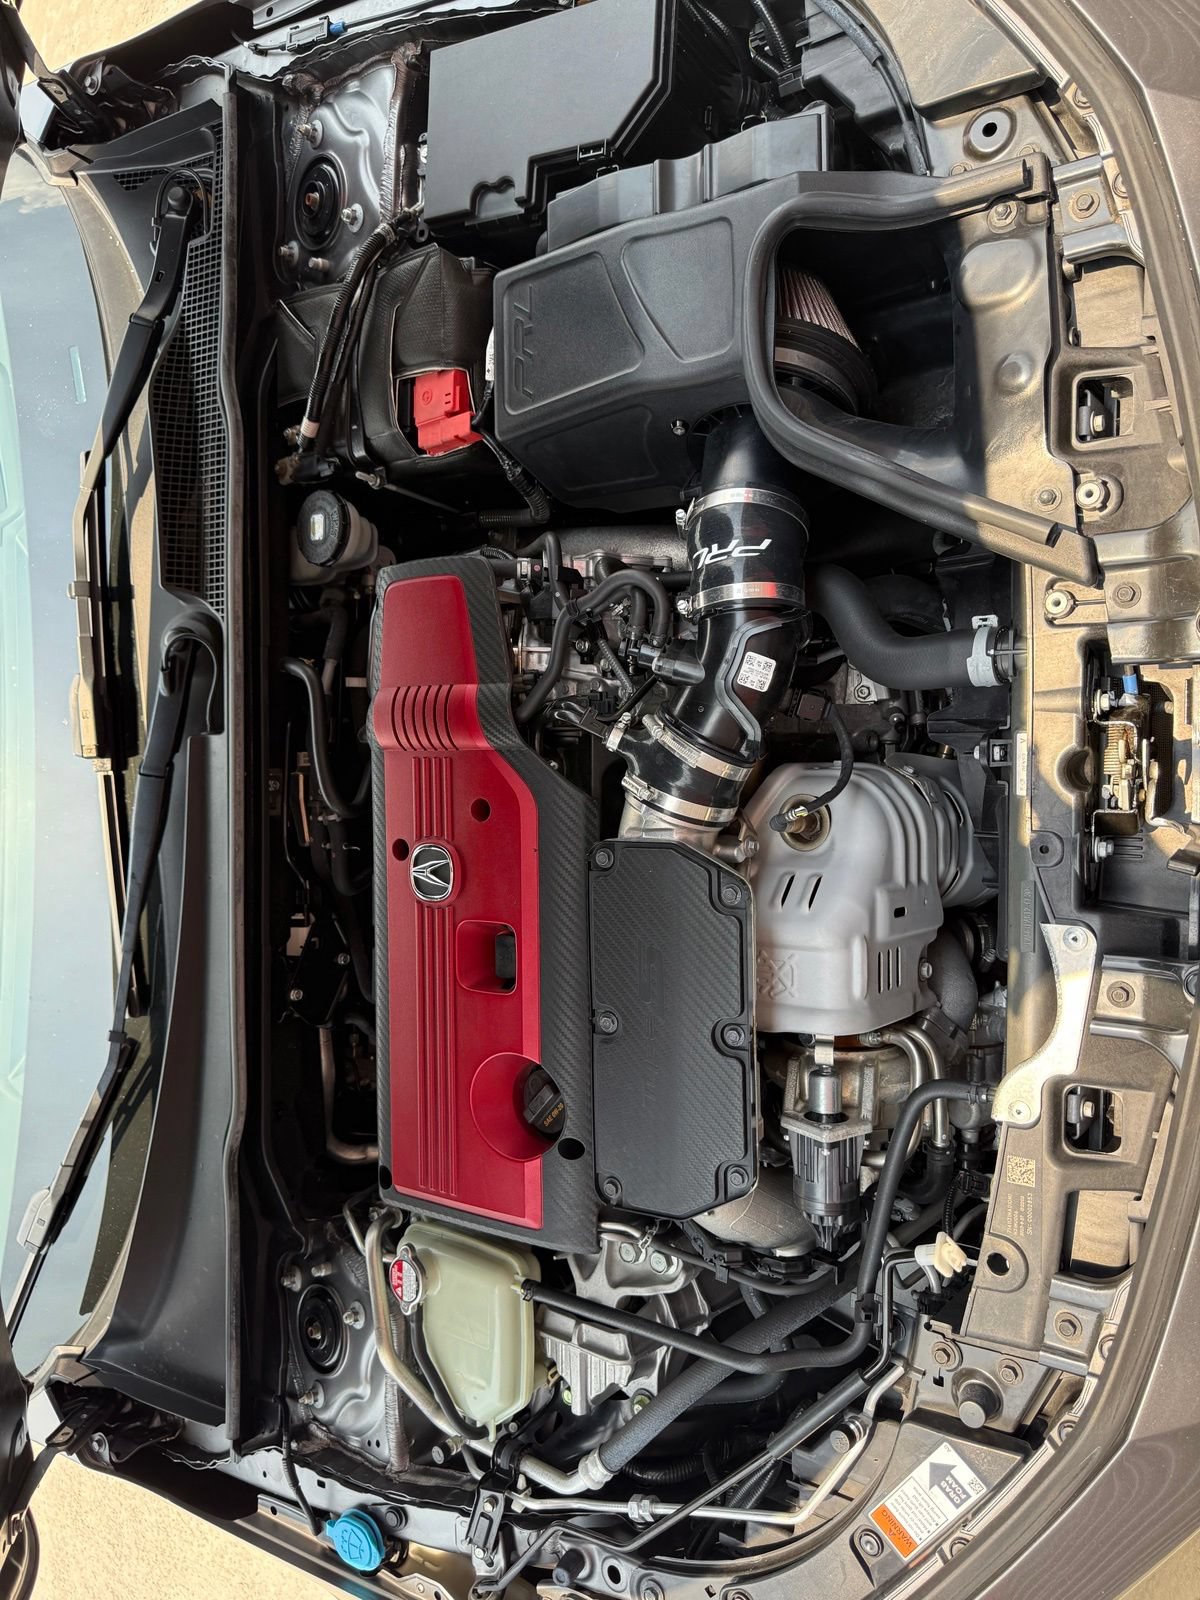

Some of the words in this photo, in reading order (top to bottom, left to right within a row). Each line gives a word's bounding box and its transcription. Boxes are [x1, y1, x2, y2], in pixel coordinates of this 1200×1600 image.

[513, 283, 533, 400] PRL
[692, 538, 772, 569] PRL
[542, 1114, 554, 1126] SAE
[549, 1102, 565, 1117] 0W-20
[939, 1479, 960, 1503] GRAB
[945, 1474, 966, 1499] FOAM
[880, 1508, 913, 1547] WARNING
